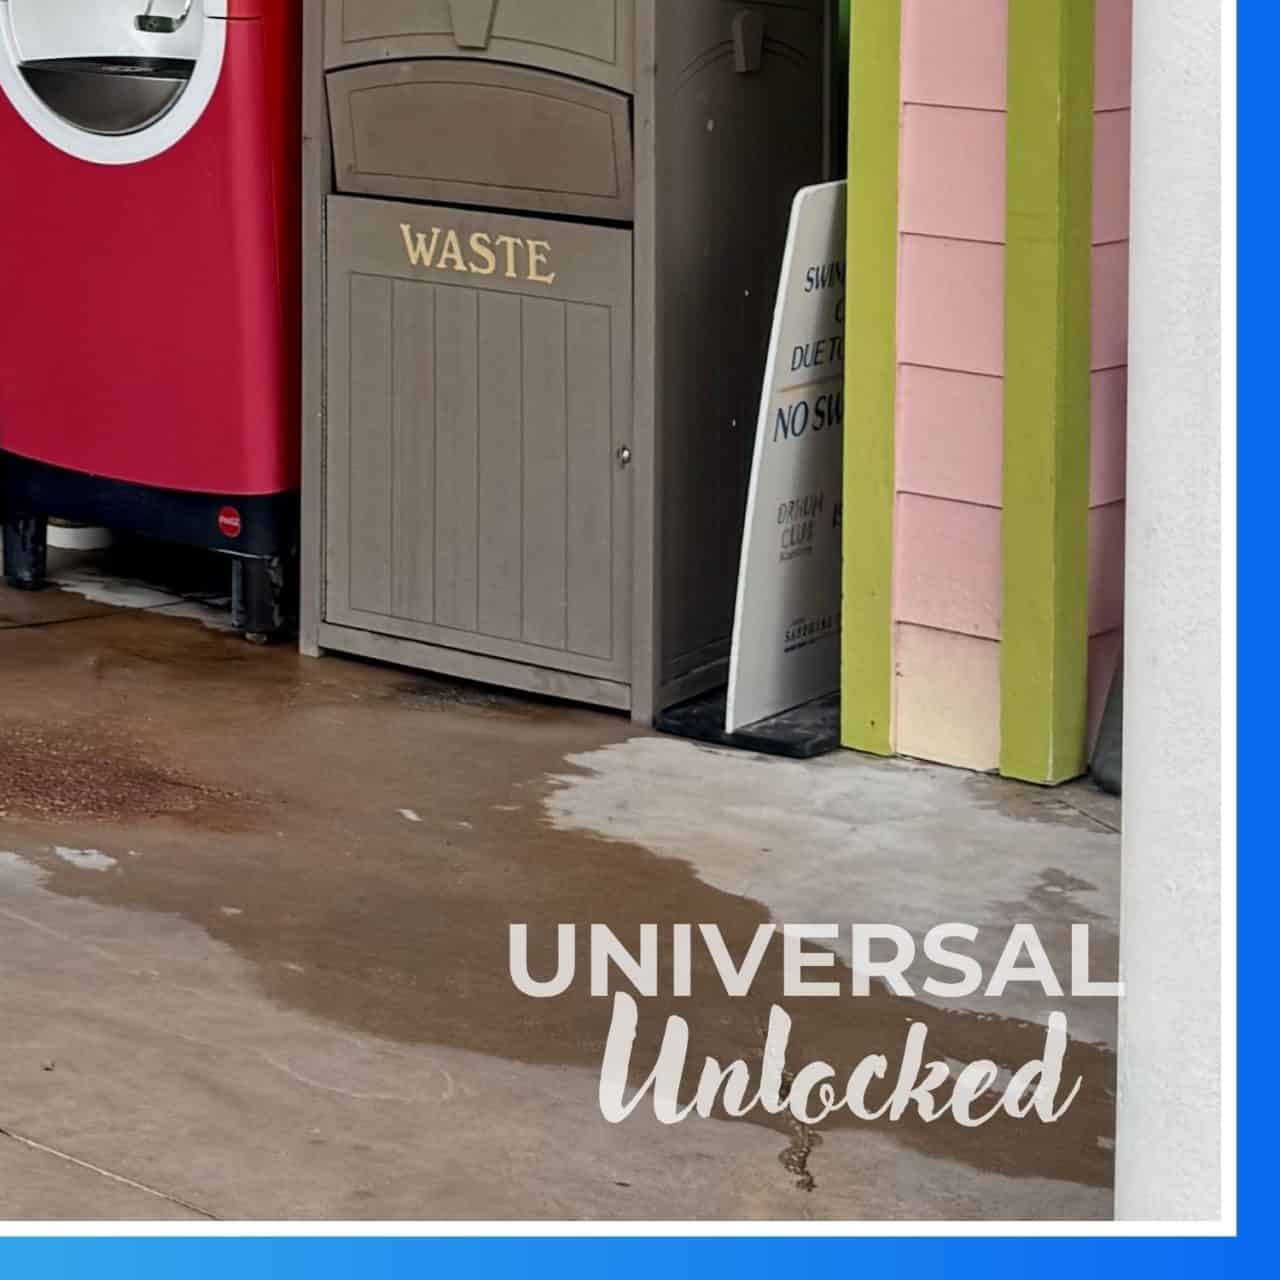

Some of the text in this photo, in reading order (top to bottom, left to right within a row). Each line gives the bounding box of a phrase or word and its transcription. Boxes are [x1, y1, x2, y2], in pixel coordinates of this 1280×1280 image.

[400, 223, 555, 284] WASTE
[791, 340, 825, 372] DUE
[773, 401, 808, 443] NO
